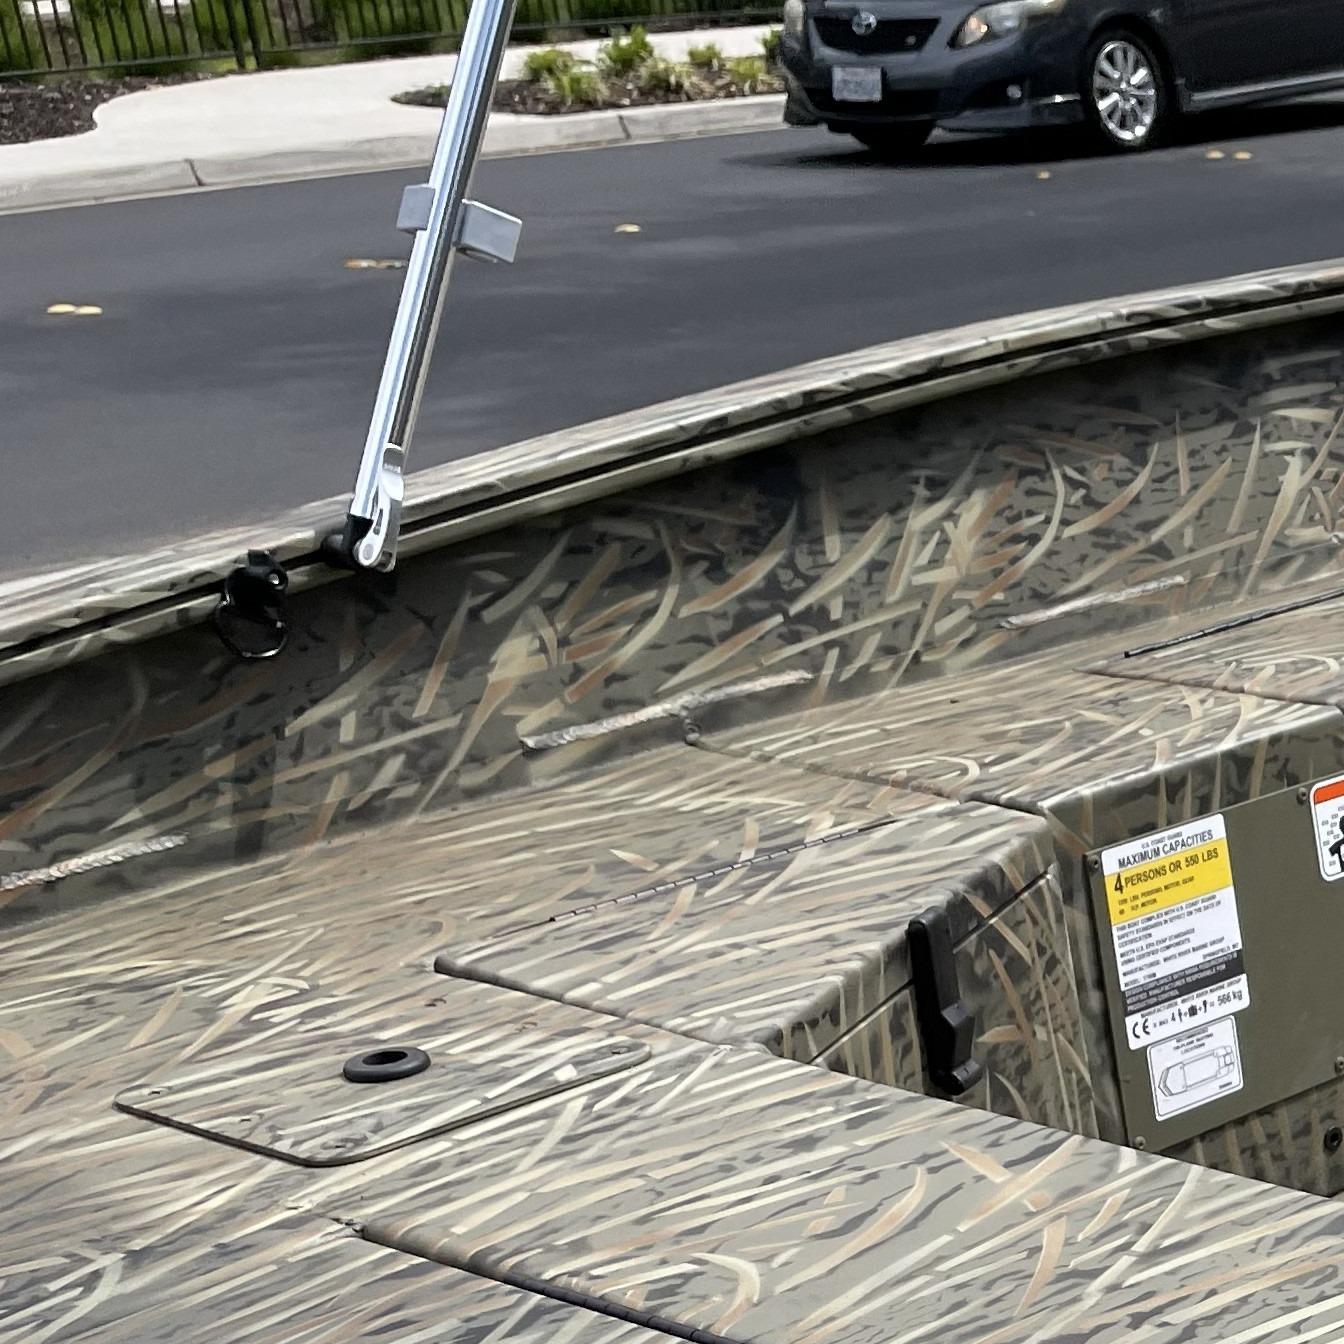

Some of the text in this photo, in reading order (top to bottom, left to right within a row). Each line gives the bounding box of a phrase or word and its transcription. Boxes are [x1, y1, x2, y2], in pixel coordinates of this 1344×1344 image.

[1118, 830, 1214, 868] MAXIMUM CAPACITIES
[1114, 873, 1124, 894] 4
[1124, 865, 1167, 888] PERSONS
[1168, 860, 1183, 874] OR
[1201, 848, 1219, 862] LBS
[1132, 1018, 1151, 1039] CE
